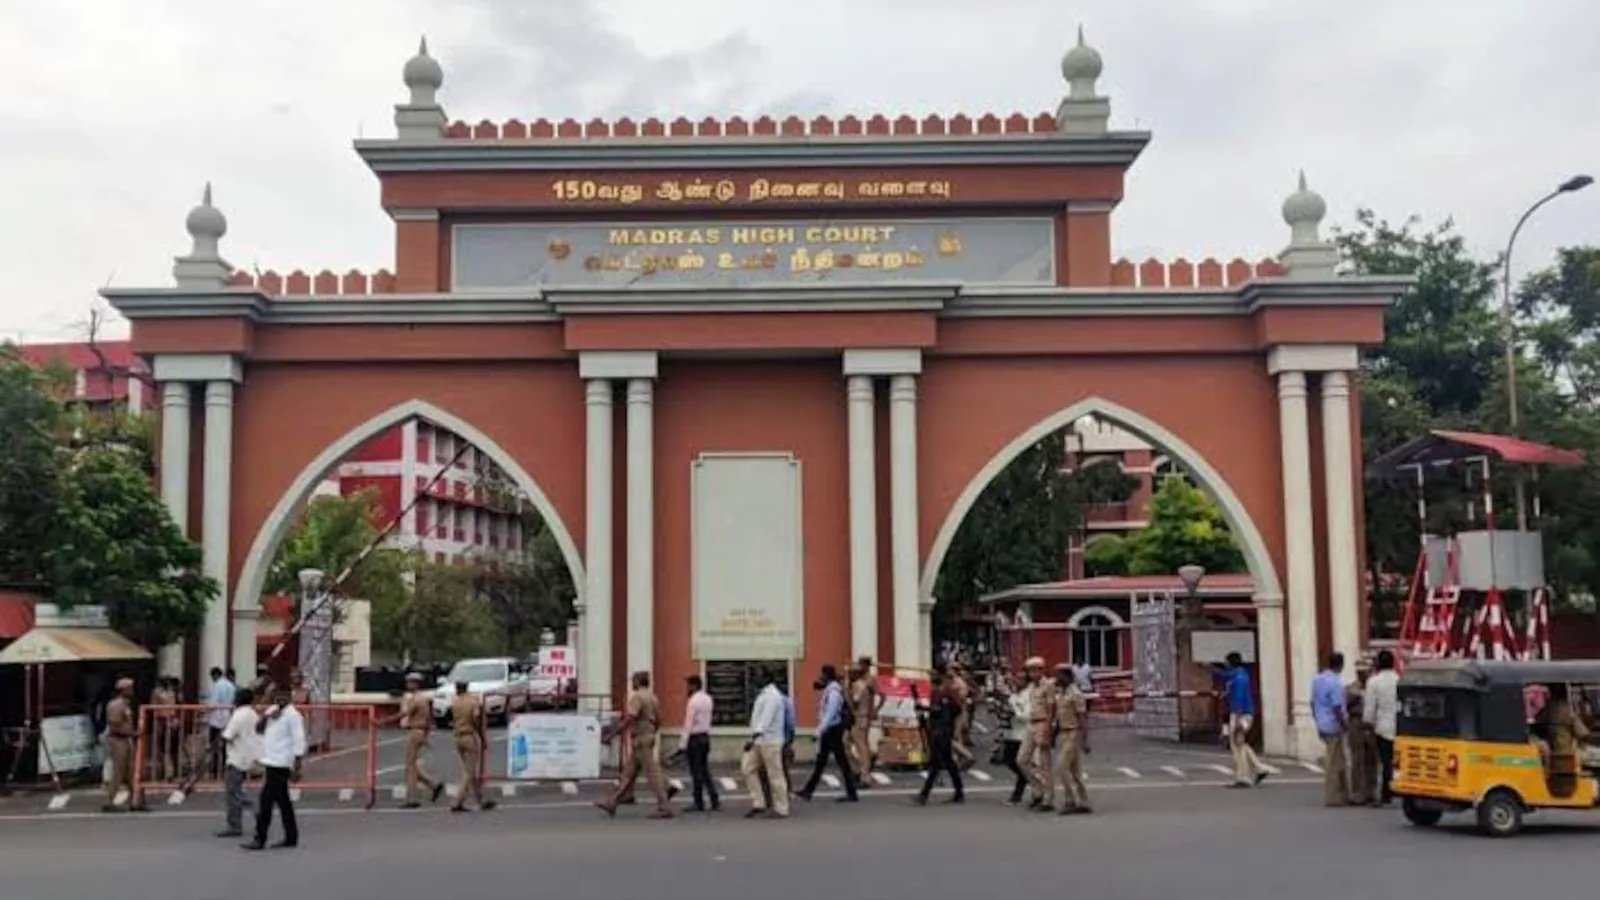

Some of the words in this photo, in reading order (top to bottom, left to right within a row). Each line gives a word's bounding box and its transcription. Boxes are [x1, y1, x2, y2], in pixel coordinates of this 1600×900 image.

[551, 179, 643, 203] 150வது
[656, 178, 735, 202] ஆண்டு
[749, 178, 844, 201] நினைவு
[858, 180, 951, 200] வளைவு
[609, 229, 720, 245] MADRAS
[732, 227, 795, 244] HIGH
[806, 226, 896, 243] COURT
